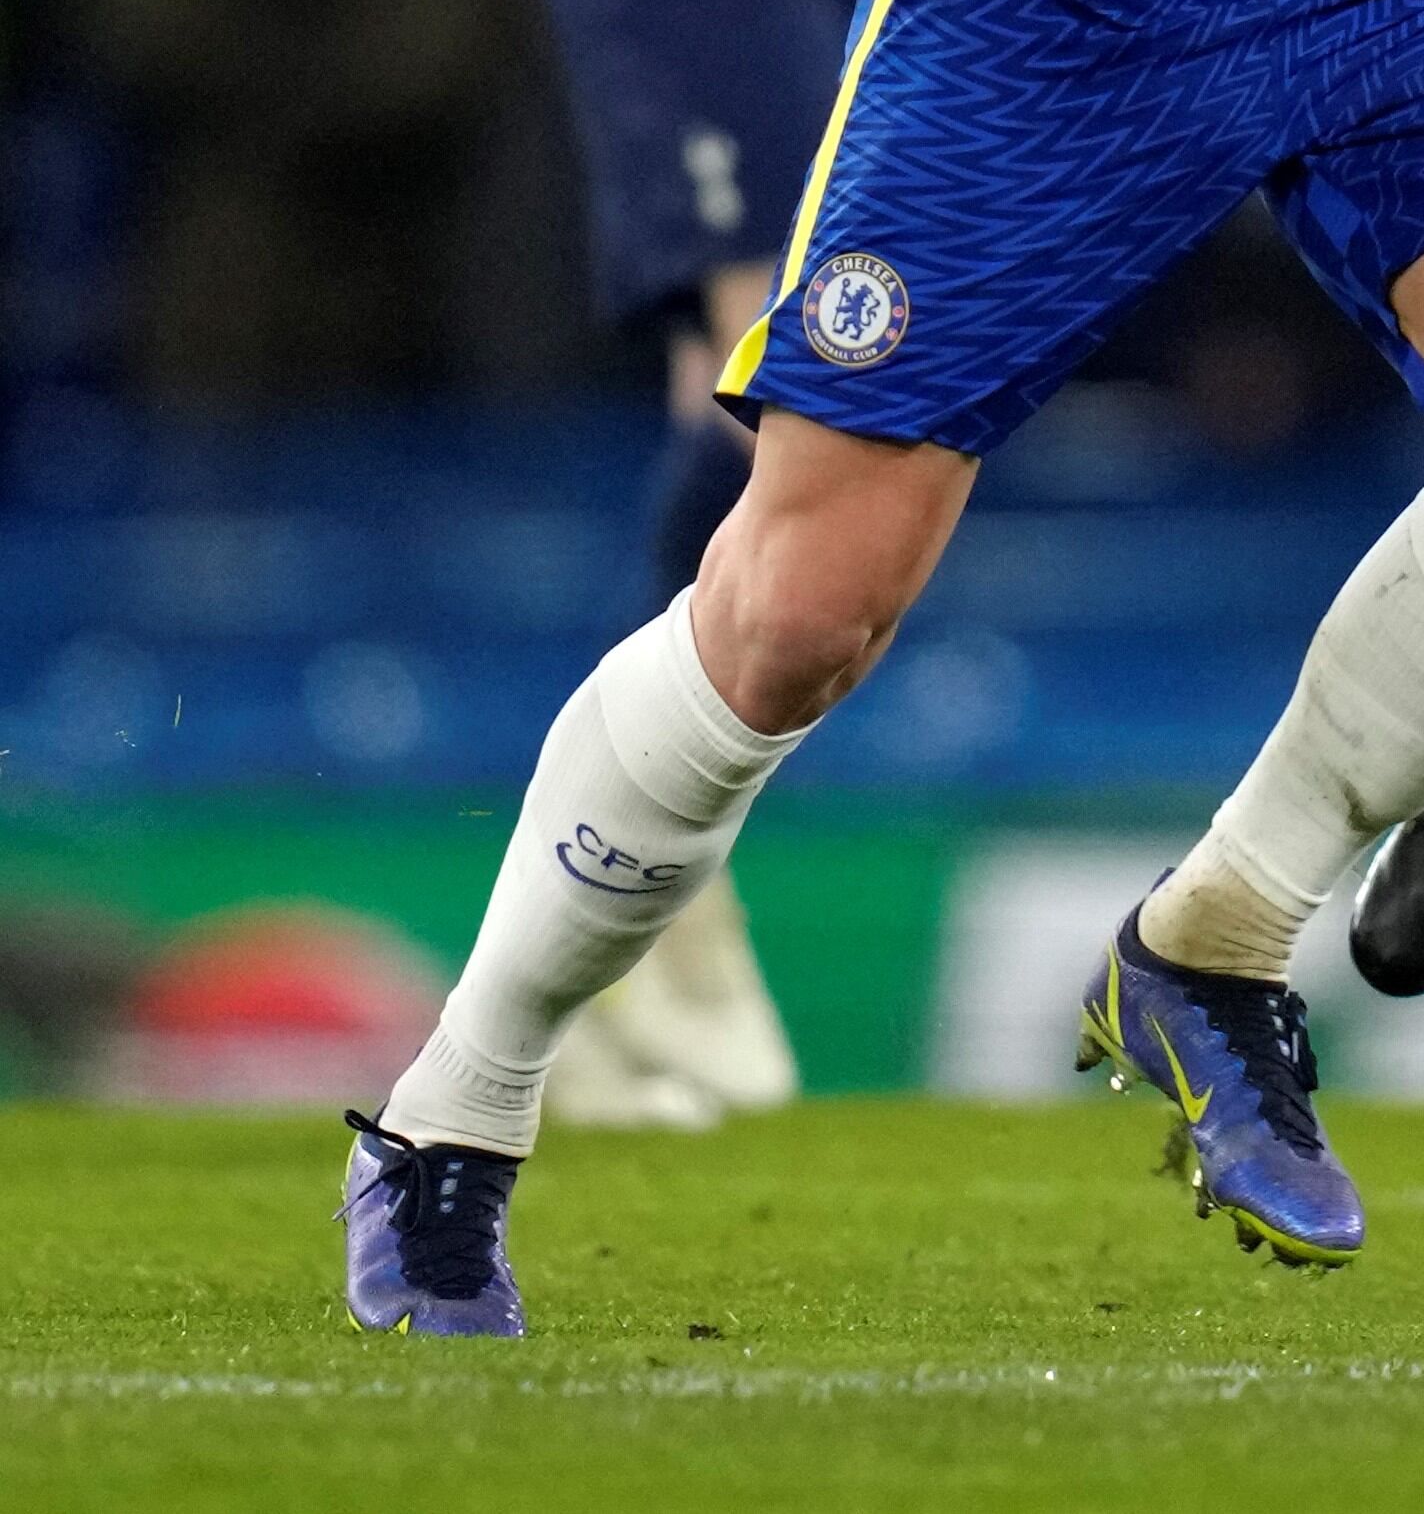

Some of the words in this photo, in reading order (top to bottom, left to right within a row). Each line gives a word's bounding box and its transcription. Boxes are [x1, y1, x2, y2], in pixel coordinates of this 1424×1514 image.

[831, 257, 898, 293] CHELSEA
[852, 347, 879, 361] CLUB
[576, 822, 686, 882] CFC
